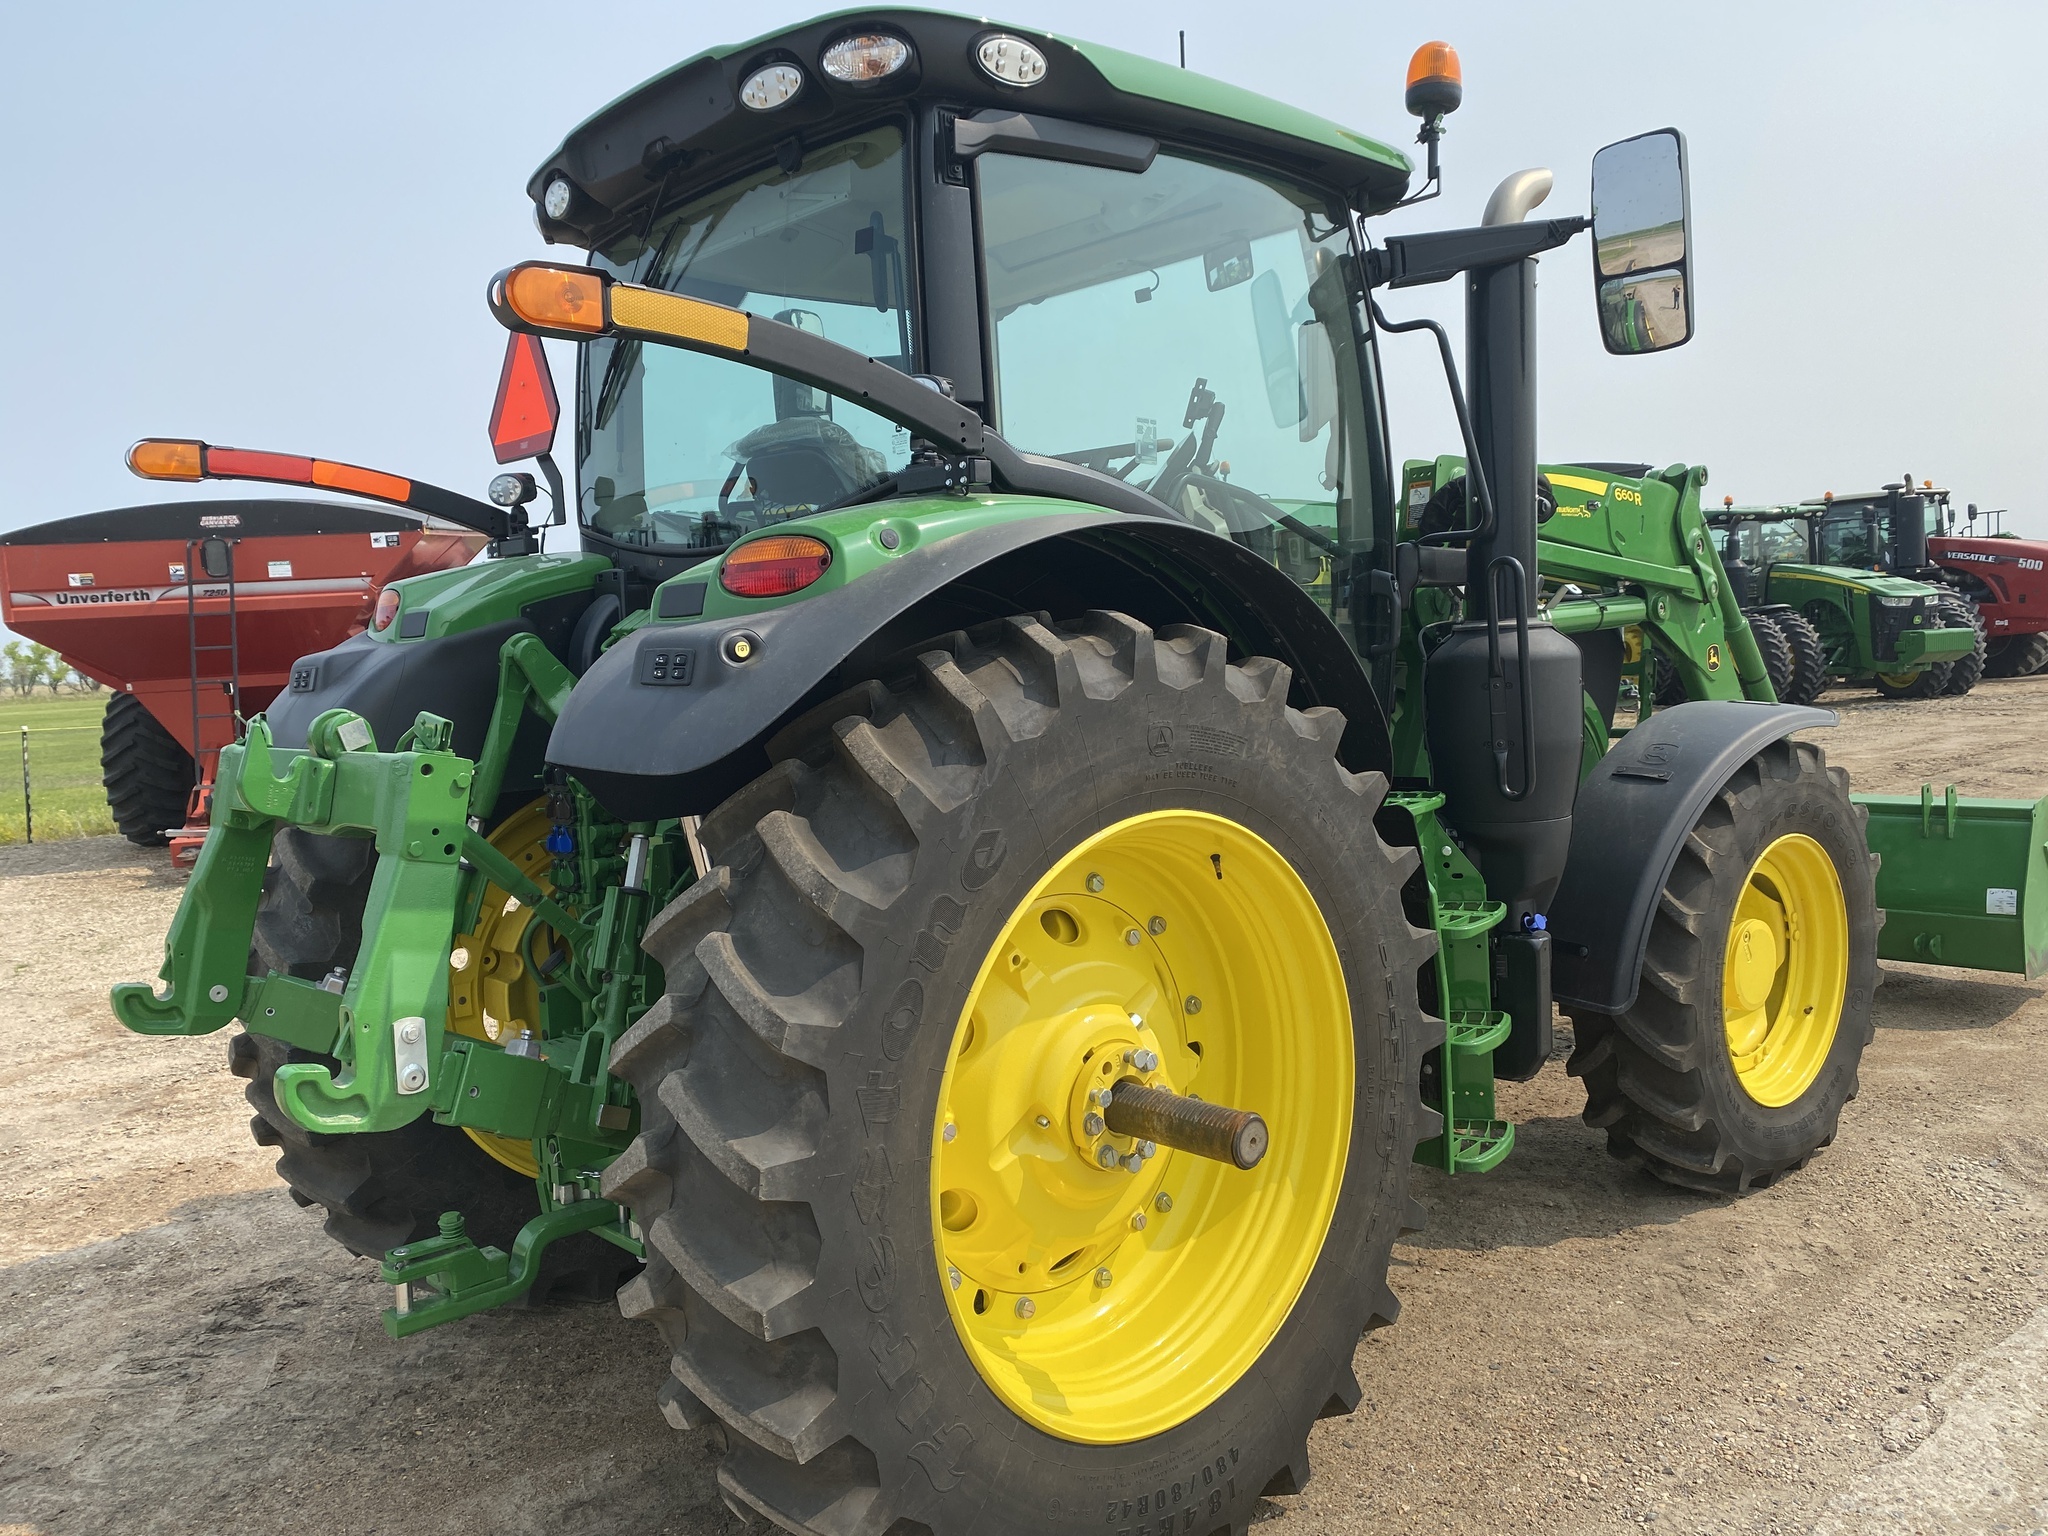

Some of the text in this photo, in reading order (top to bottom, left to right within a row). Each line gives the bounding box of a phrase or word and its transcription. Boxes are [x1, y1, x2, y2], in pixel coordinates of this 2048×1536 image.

[1947, 551, 1996, 563] VERSATILE
[2017, 557, 2044, 571] 500
[56, 589, 150, 605] Unverferth
[202, 589, 228, 597] 7250
[1366, 1064, 1376, 1118] RADIAL
[851, 828, 1008, 1494] Firestone
[1105, 1446, 1240, 1525] 480/80R42
